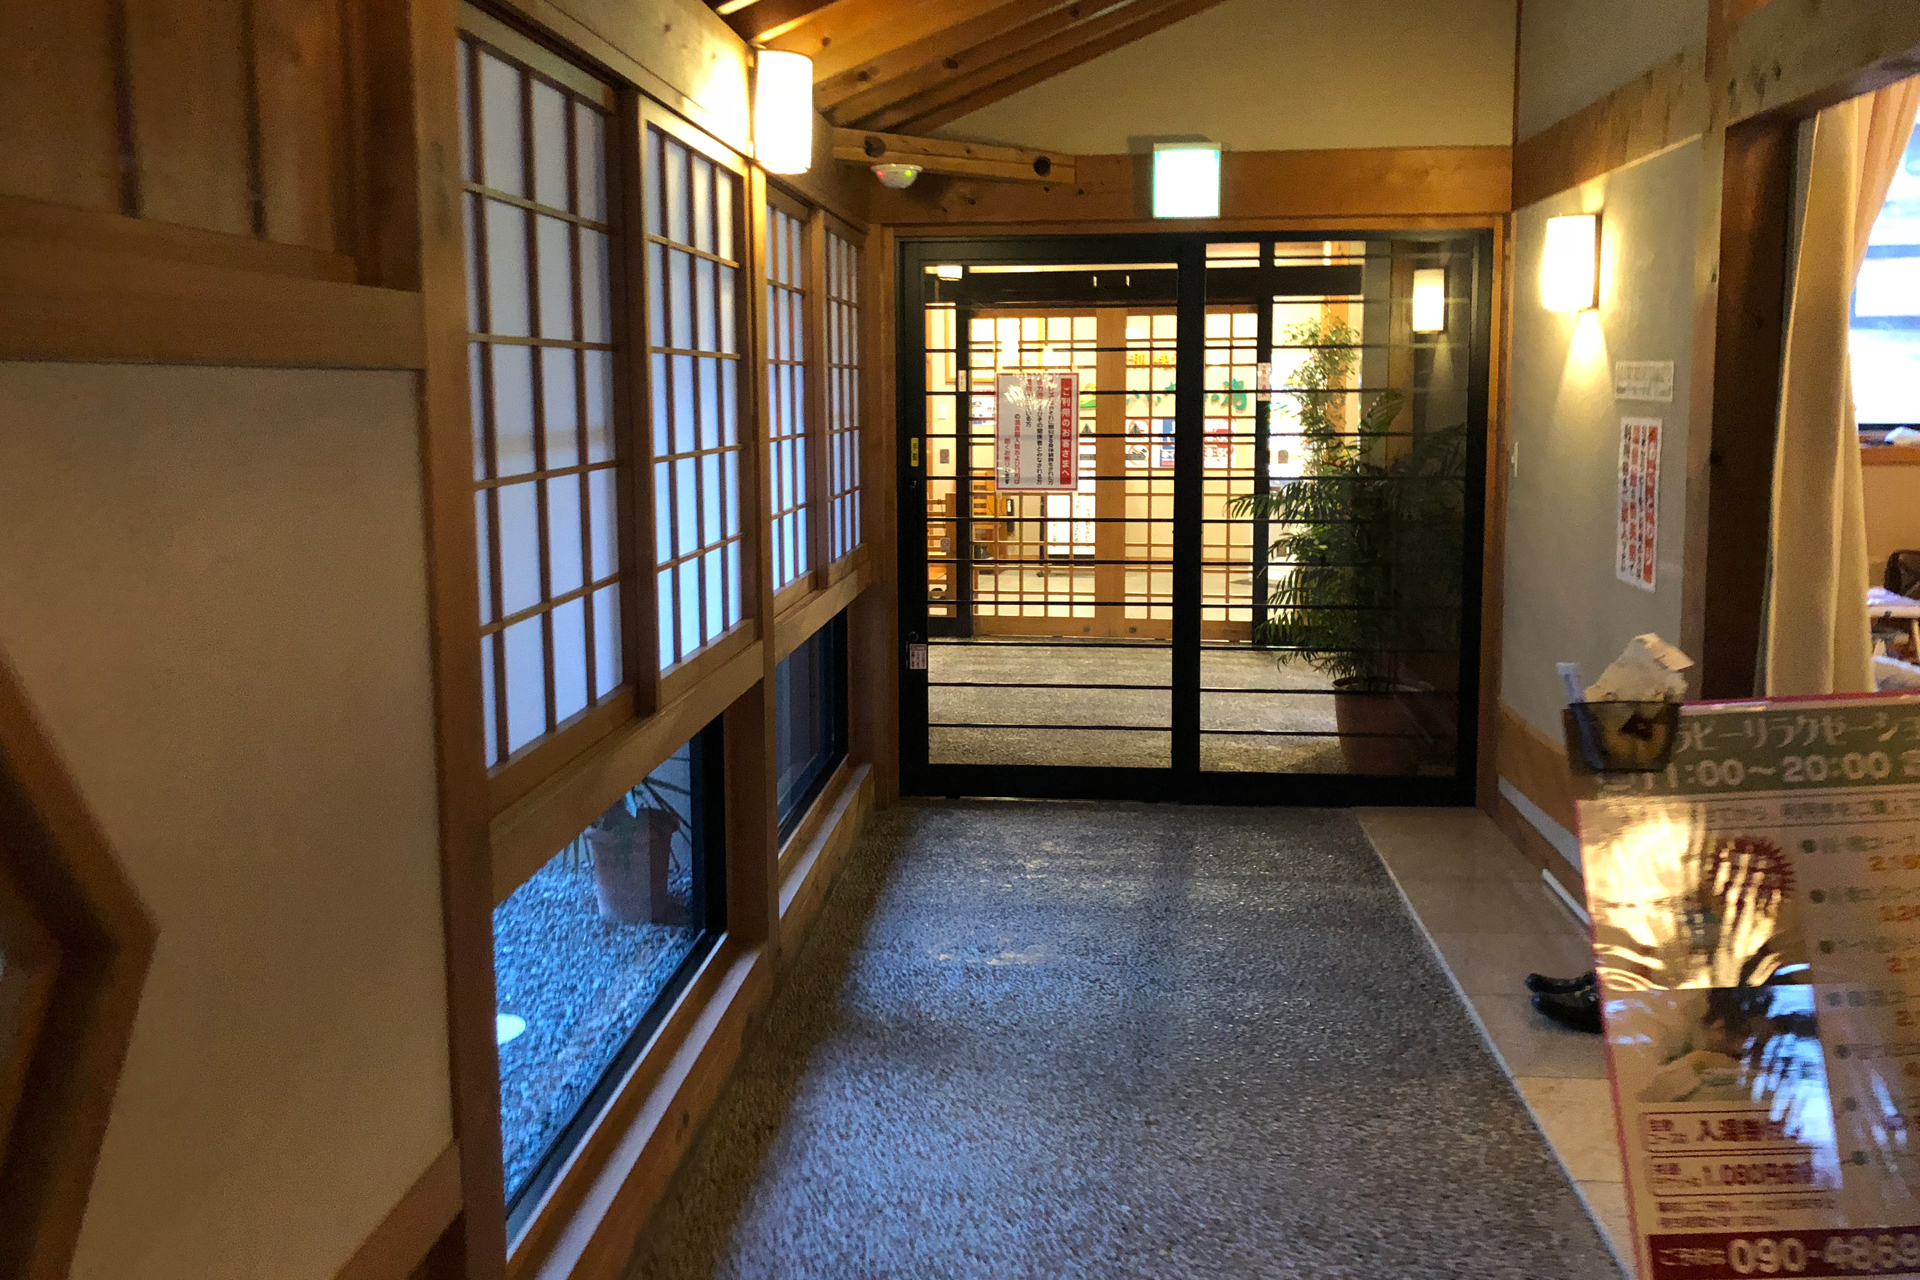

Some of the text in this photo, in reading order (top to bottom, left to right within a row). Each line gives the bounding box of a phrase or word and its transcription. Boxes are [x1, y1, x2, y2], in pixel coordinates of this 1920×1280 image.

[1061, 387, 1071, 476] ご利用のお客さまへ
